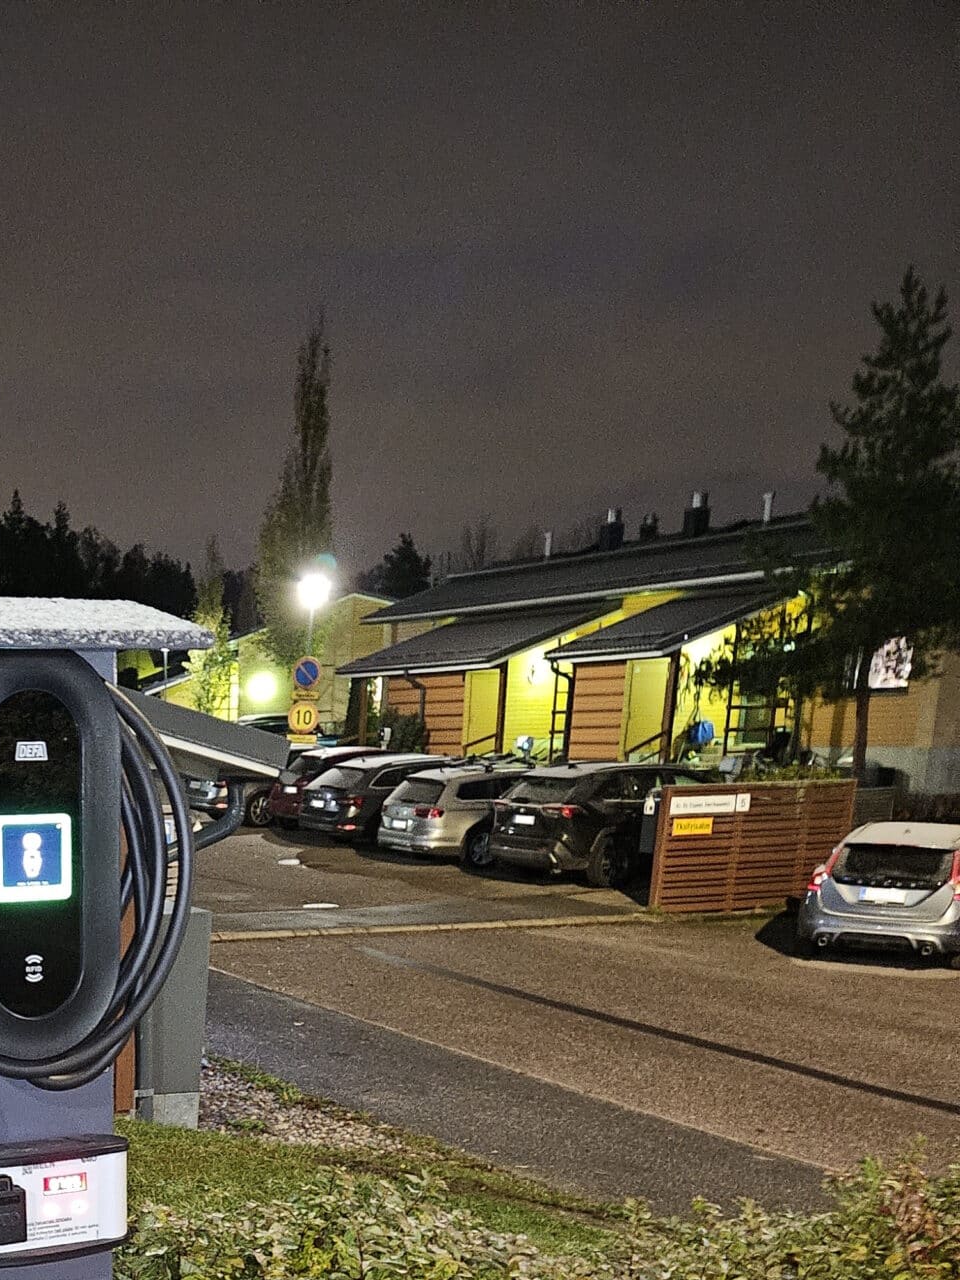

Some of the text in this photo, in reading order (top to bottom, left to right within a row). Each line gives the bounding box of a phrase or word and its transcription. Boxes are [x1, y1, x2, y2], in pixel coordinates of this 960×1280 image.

[296, 710, 312, 725] 10
[17, 743, 45, 759] DEFA
[25, 965, 43, 973] RFID
